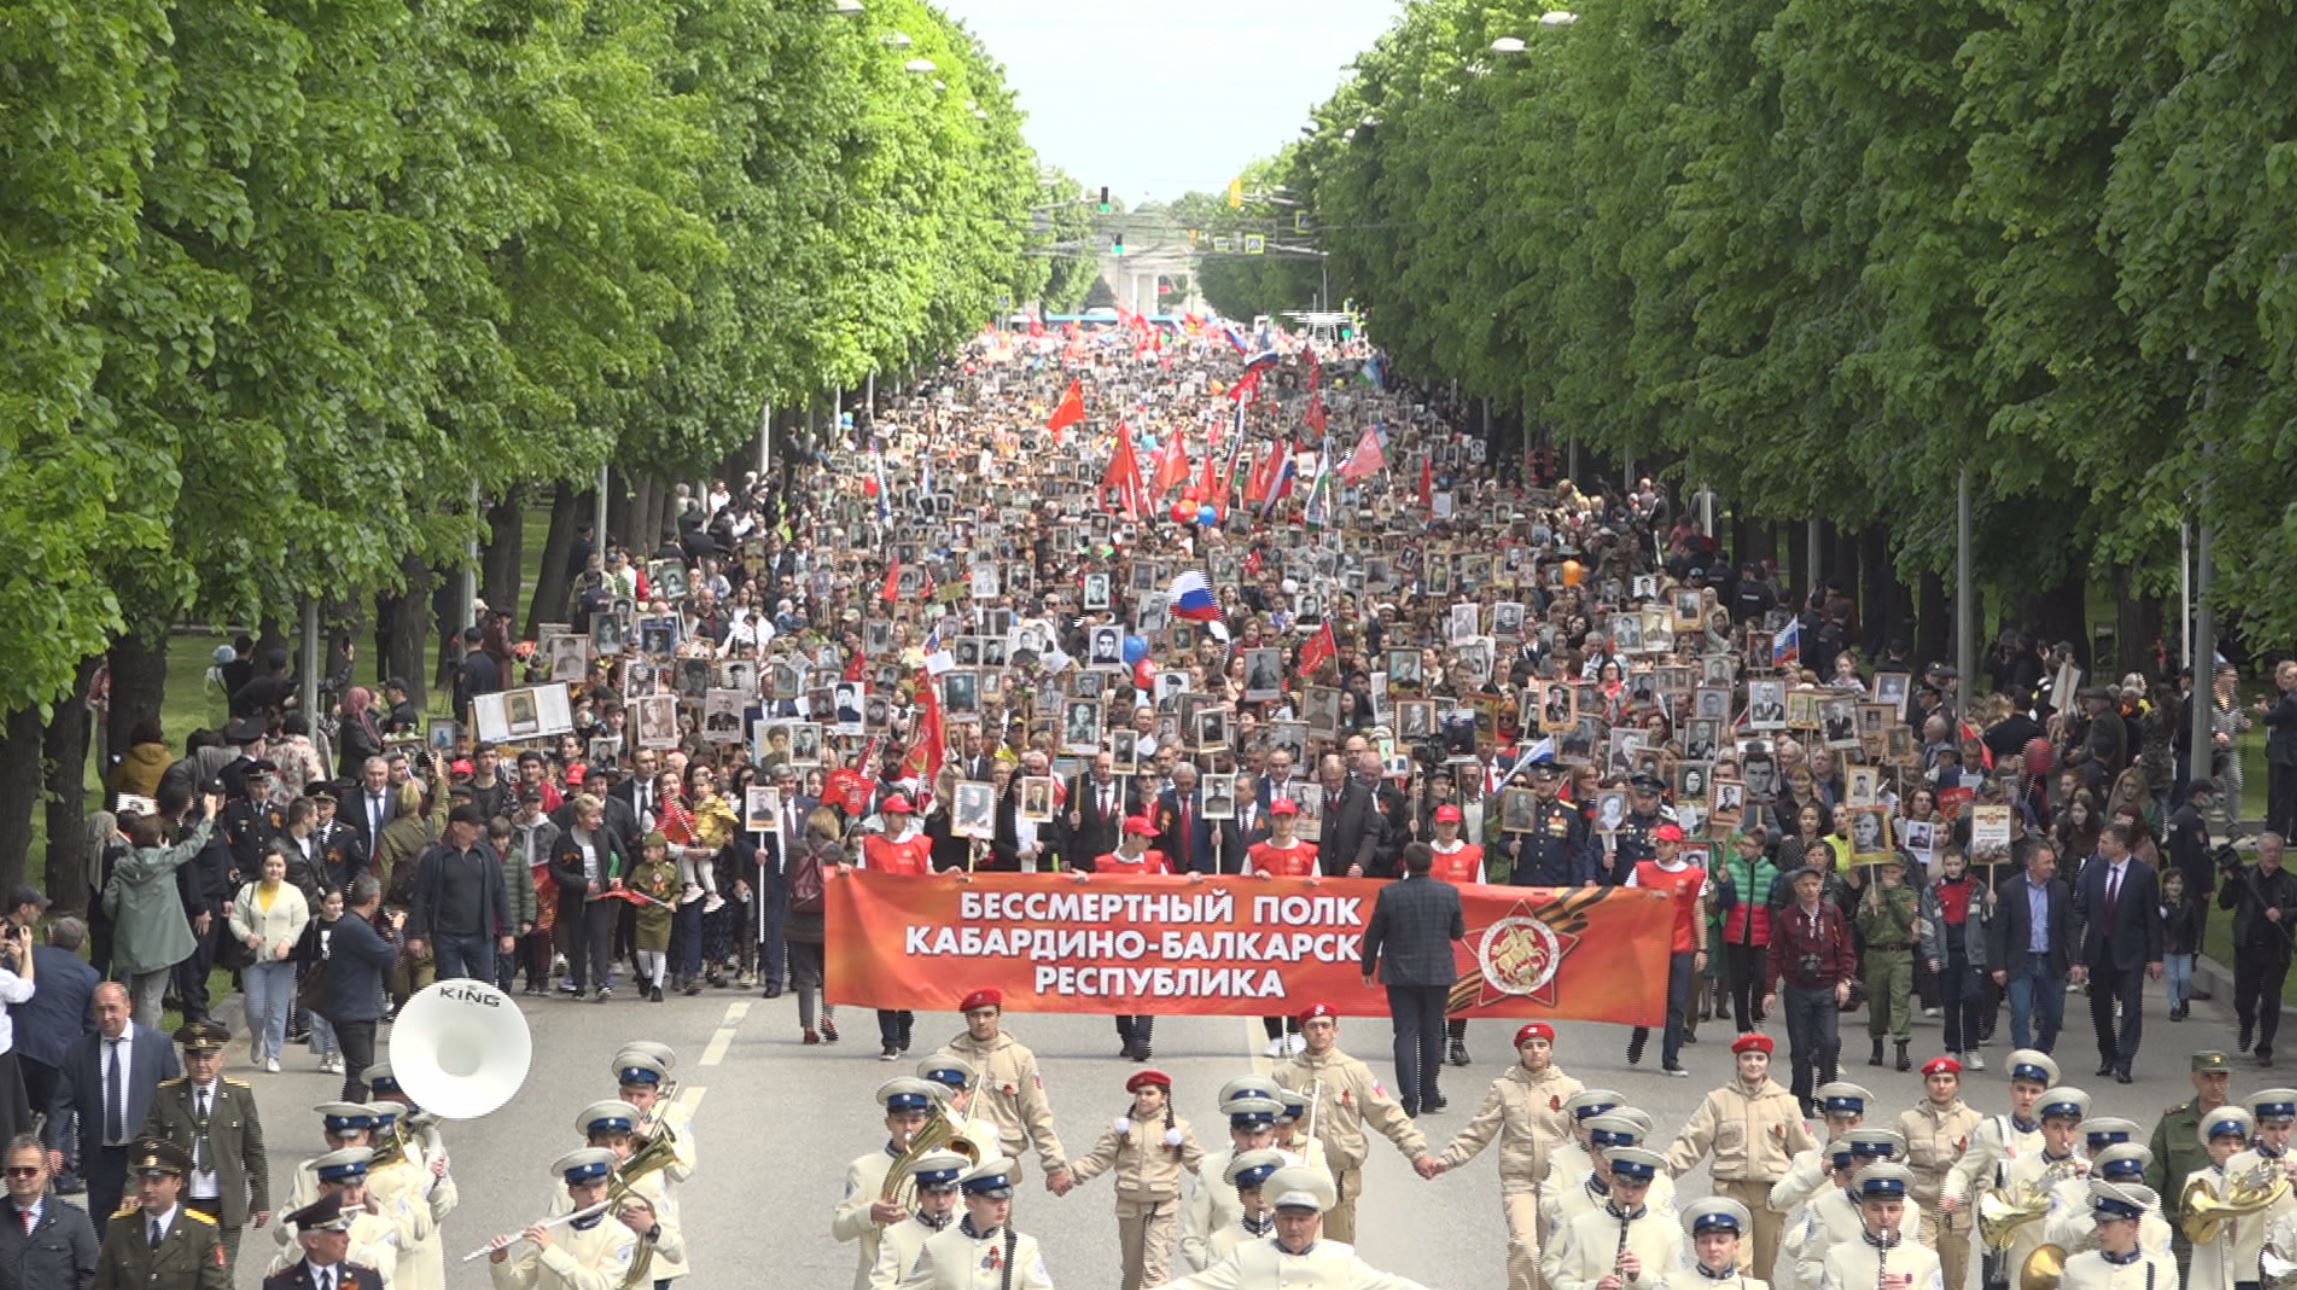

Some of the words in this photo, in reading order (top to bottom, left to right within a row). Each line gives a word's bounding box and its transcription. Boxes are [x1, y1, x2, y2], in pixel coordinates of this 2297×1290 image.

[960, 888, 1235, 924] БЕССМЕРТНЫЙ
[1253, 894, 1363, 926] ПОЛК
[904, 925, 1363, 962] КАБАРДИНО-БАЛКАРСК
[439, 986, 501, 1008] KING
[1034, 964, 1286, 999] РЕСПУБЛИКА
